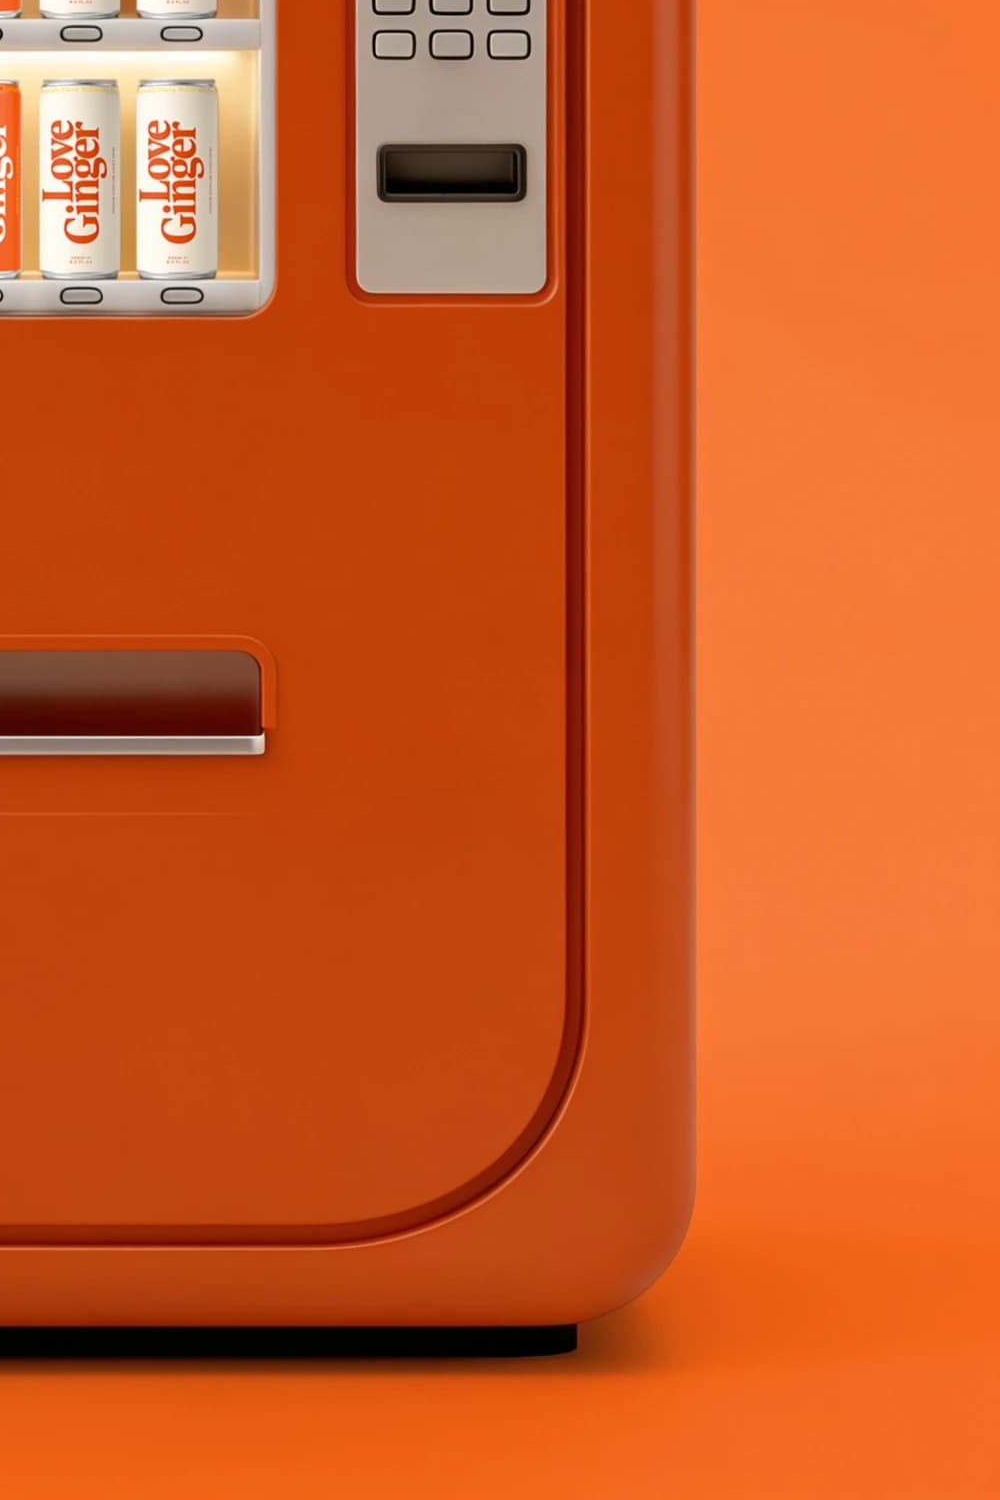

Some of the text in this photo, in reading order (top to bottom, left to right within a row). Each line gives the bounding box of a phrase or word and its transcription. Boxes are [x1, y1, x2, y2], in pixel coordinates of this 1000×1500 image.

[42, 120, 74, 203] Love
[64, 121, 108, 245] Ginger
[139, 120, 171, 203] Love
[161, 121, 205, 245] Ginger
